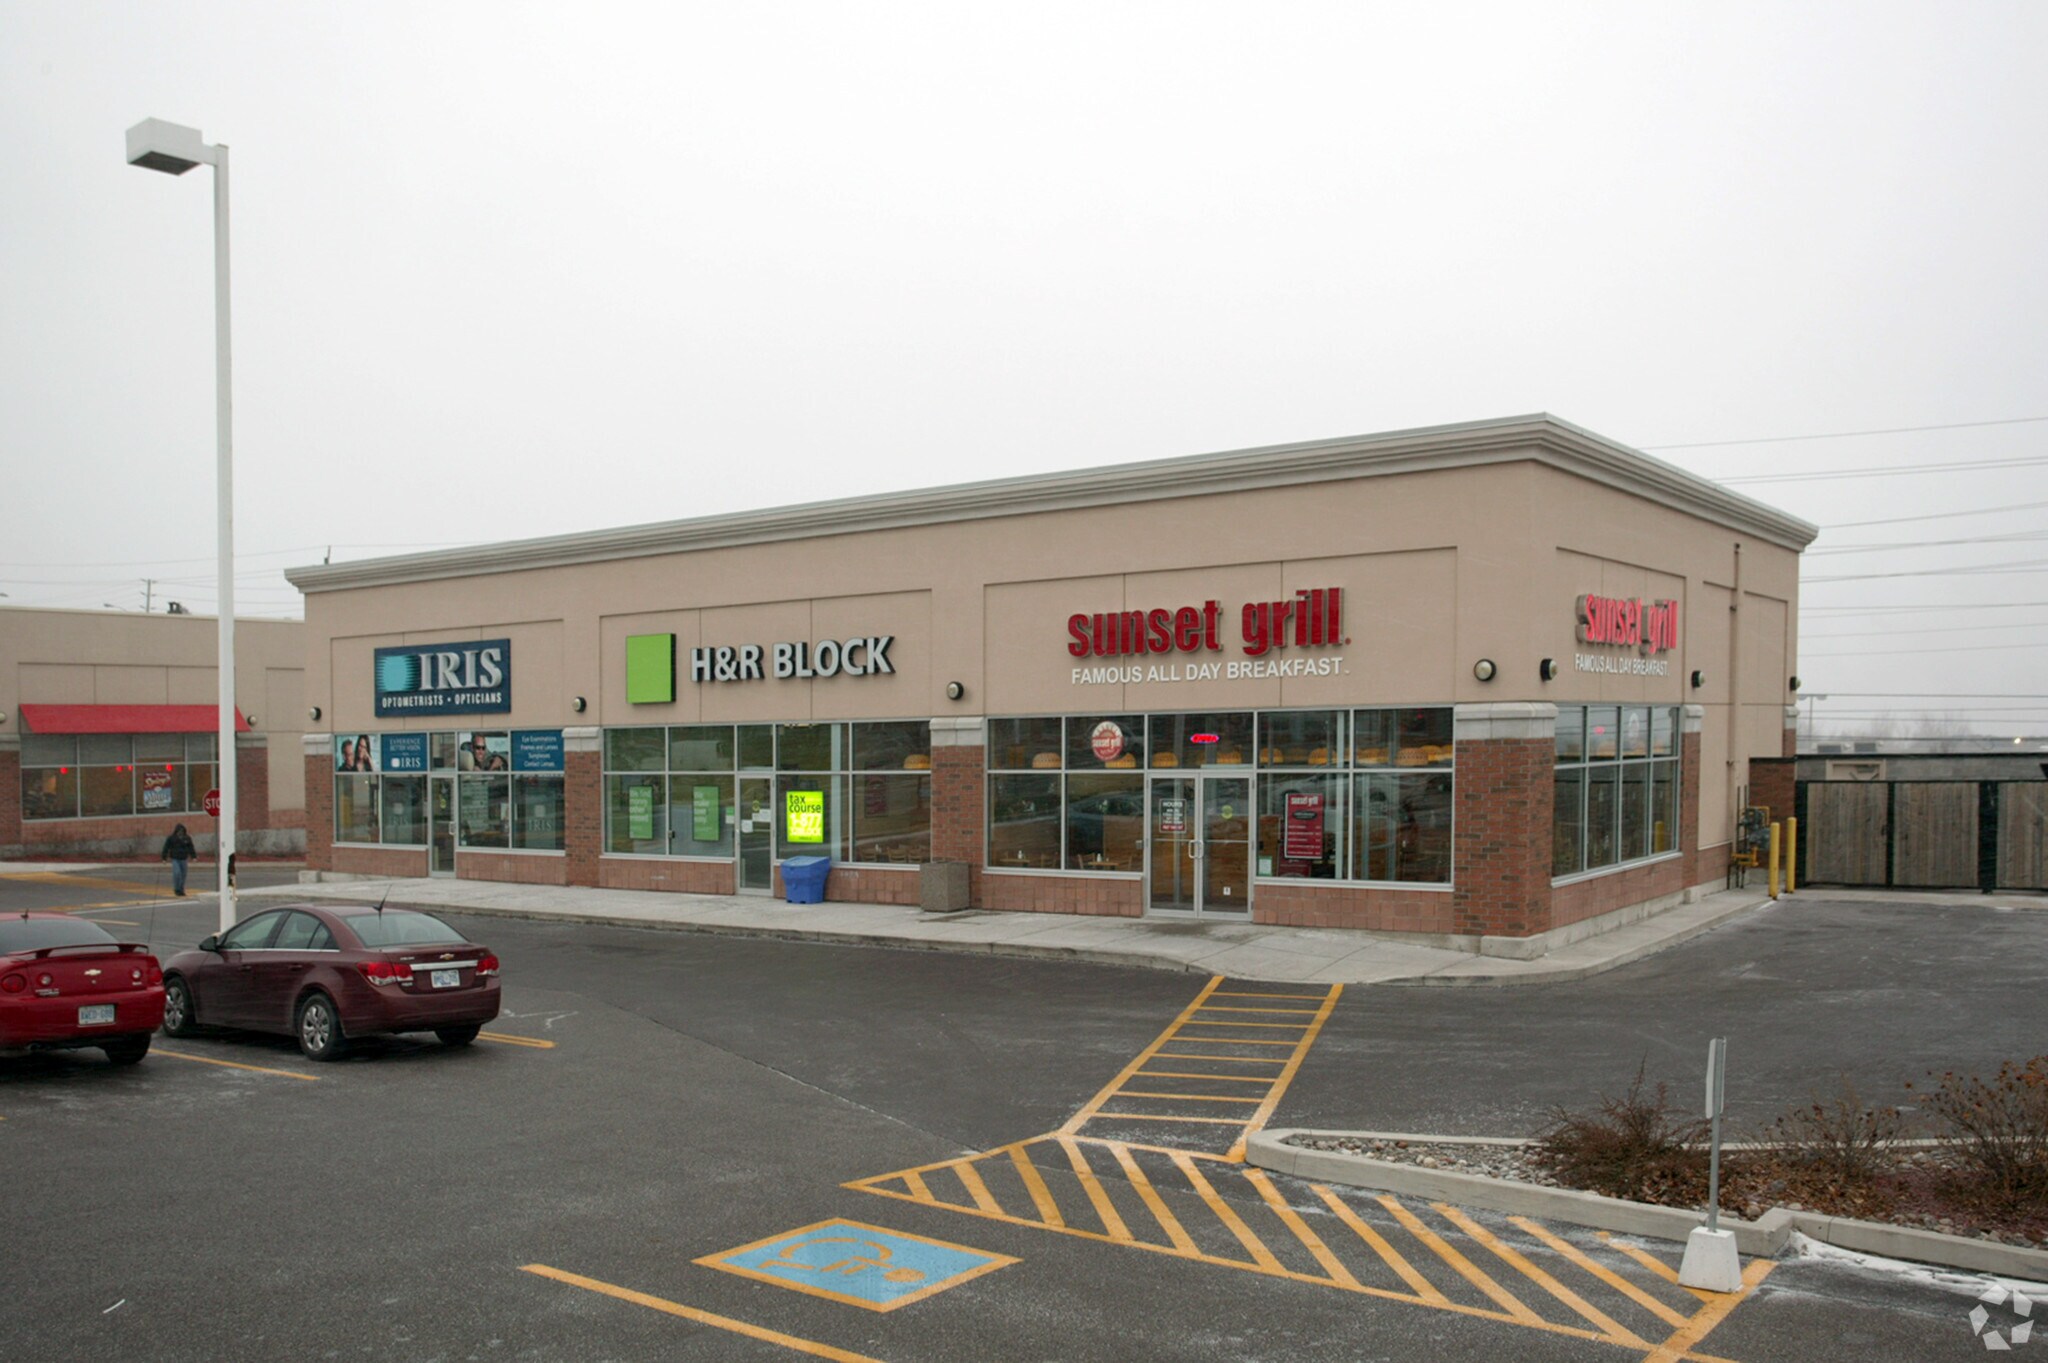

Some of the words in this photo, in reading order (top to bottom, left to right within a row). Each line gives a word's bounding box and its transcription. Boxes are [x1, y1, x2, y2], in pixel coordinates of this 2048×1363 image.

[1067, 599, 1222, 657] sunset
[1241, 587, 1344, 656] grill
[1576, 593, 1643, 645] sunset
[1645, 599, 1678, 654] grill
[690, 645, 764, 682] H&R
[772, 636, 895, 678] BLOCK
[1575, 654, 1605, 672] FAMOUS
[1605, 656, 1618, 673] ALL
[1619, 658, 1632, 674] DAY
[418, 648, 503, 690] IRIS
[1071, 666, 1143, 685] FAMOUS
[1147, 664, 1180, 682] ALL
[1186, 663, 1222, 681] DAY
[1227, 657, 1343, 679] BREAKFAST
[382, 695, 444, 709] OPTOMETRISTS
[454, 692, 502, 705] OPTICIANS
[401, 757, 421, 768] IRIS
[205, 798, 220, 810] STO
[788, 803, 822, 813] course
[789, 794, 806, 805] tax
[528, 819, 552, 832] IRIS
